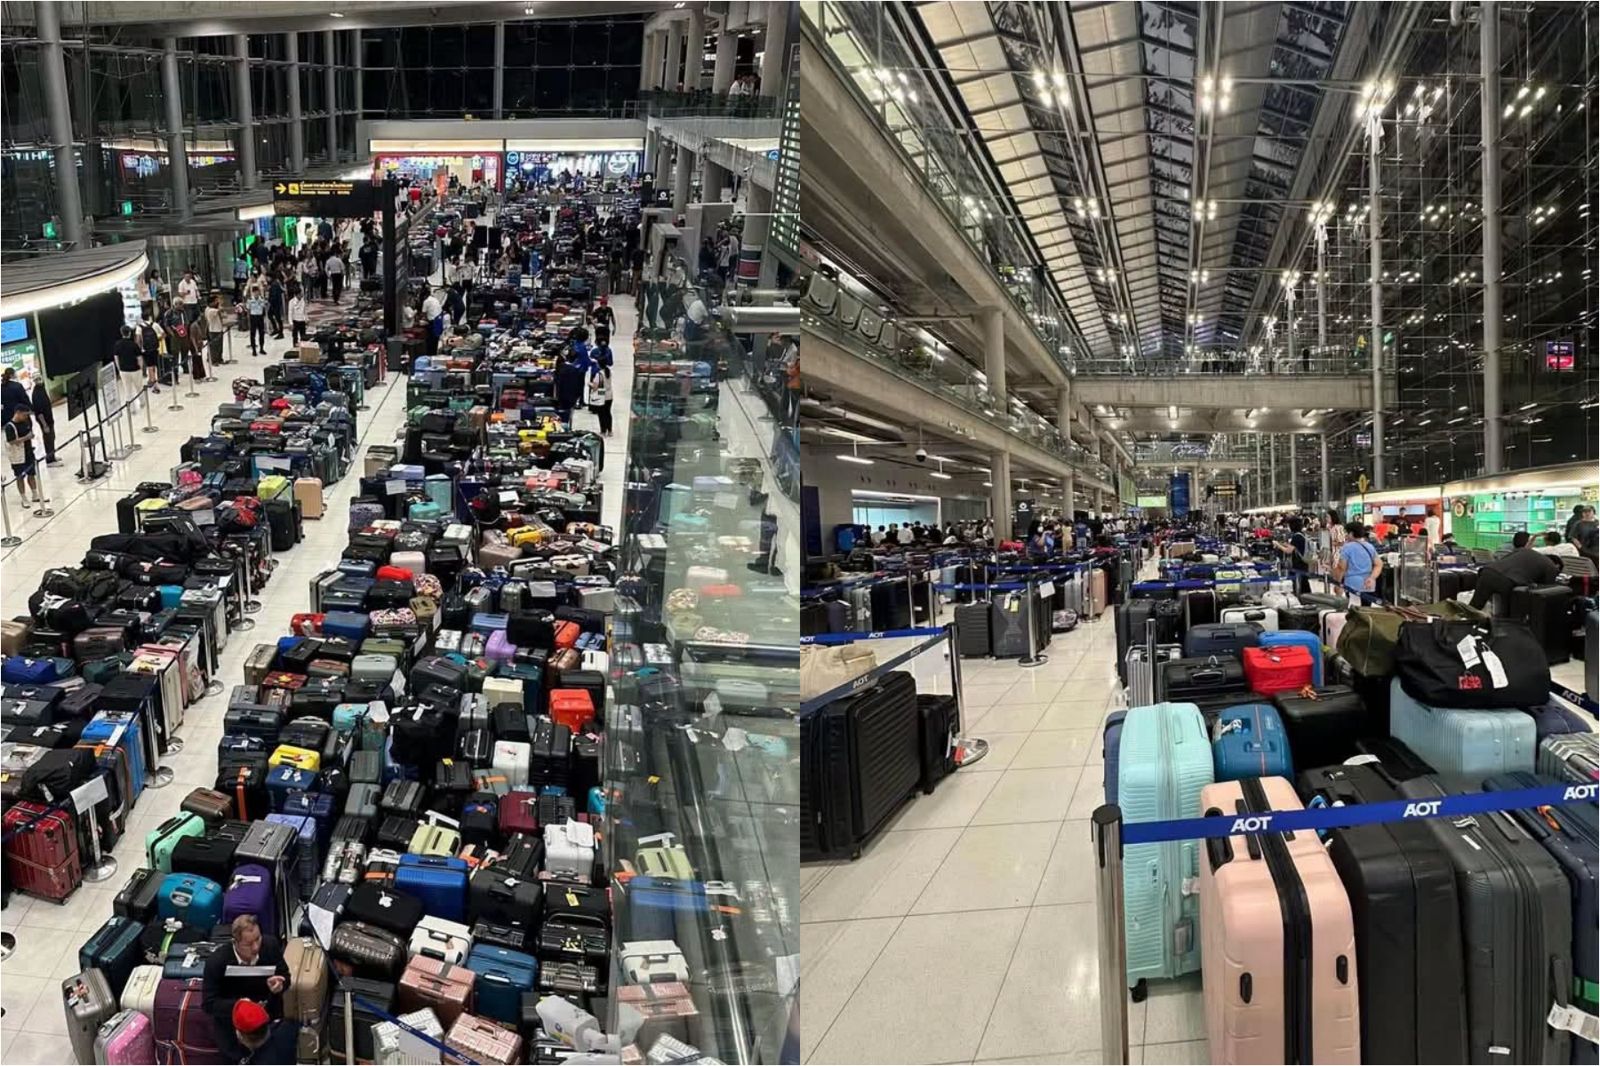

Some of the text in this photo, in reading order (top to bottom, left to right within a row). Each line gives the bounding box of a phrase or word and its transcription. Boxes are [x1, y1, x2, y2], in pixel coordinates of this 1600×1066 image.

[853, 674, 870, 689] AOT
[1561, 690, 1585, 705] AOT
[1563, 784, 1599, 800] AOT
[1403, 801, 1443, 817] AOT
[1231, 816, 1273, 833] AOT
